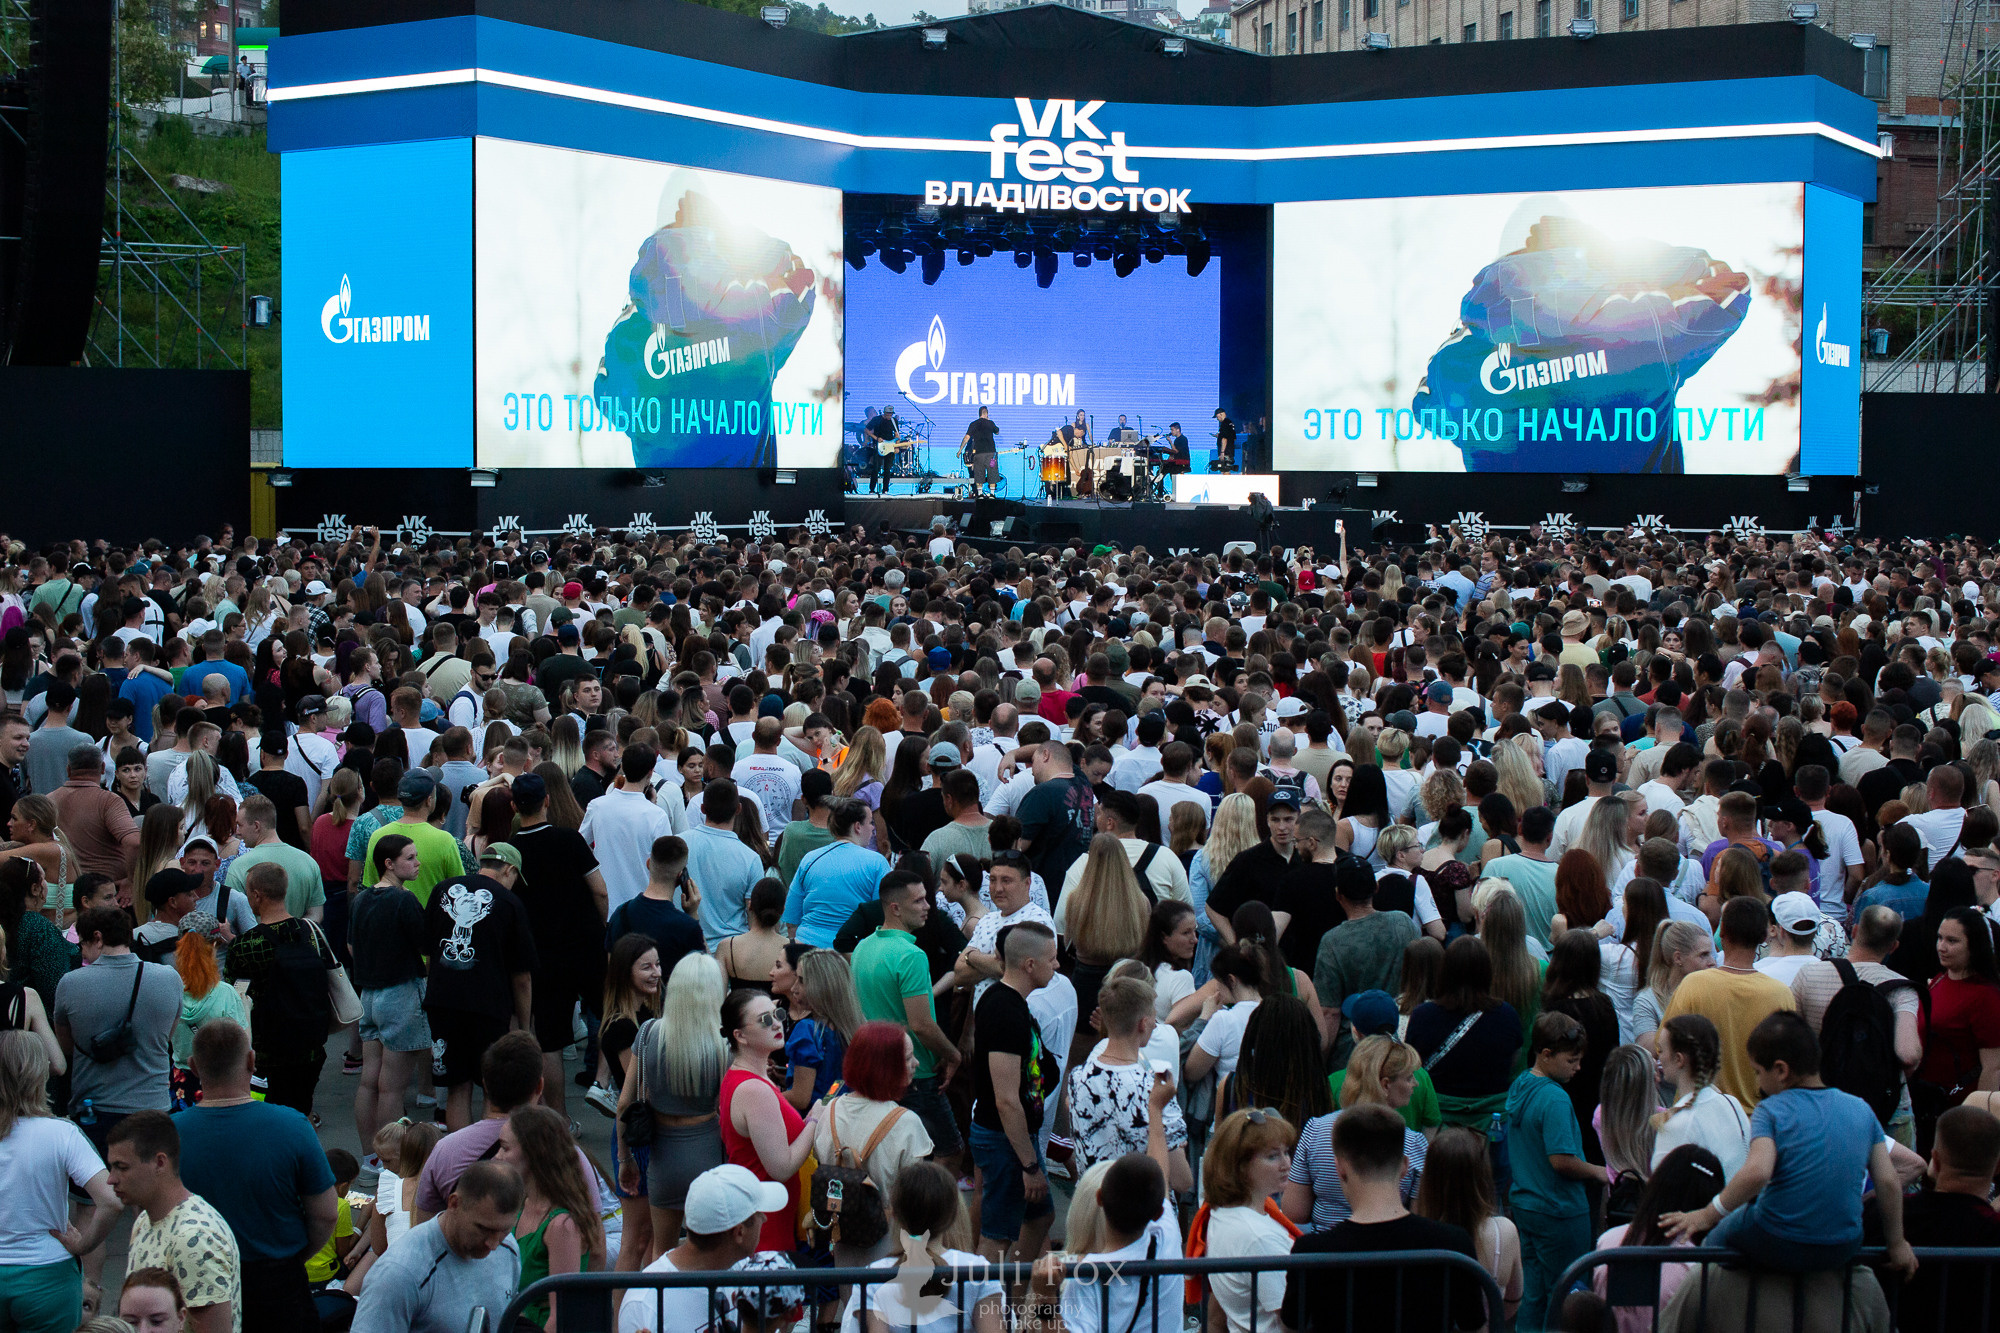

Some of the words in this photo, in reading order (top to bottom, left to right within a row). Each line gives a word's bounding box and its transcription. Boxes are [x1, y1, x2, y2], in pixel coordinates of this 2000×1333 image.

[1014, 97, 1107, 139] VK
[990, 123, 1139, 183] fest
[925, 180, 1191, 213] ВЛАДИВОСТОК
[353, 315, 430, 343] ГАЗПРОМ
[670, 337, 731, 375] ГАЗПРОМ
[1517, 350, 1608, 391] ГАЗПРОМ
[950, 372, 1075, 405] ГАЗПРОМ
[503, 393, 553, 431] ЭТО
[564, 394, 661, 433] ТОЛЬКО
[671, 398, 762, 435] НАЧАЛО
[770, 401, 823, 436] ПУТИ
[1303, 408, 1362, 441] ЭТО
[1376, 408, 1502, 441] ТОЛЬКО
[1518, 408, 1658, 441] НАЧАЛО
[1673, 408, 1765, 441] ПУТИ
[323, 514, 347, 527] VK
[403, 515, 427, 530] VK
[498, 515, 520, 530] VK
[568, 513, 589, 528] VK
[633, 512, 653, 526] VK
[695, 511, 713, 524] VK
[753, 510, 770, 523] VK
[809, 509, 825, 522] VK
[1457, 511, 1484, 524] VK
[1546, 512, 1573, 525] VK
[1636, 514, 1665, 527] VK
[1730, 516, 1759, 529] VK
[748, 518, 777, 536] fest
